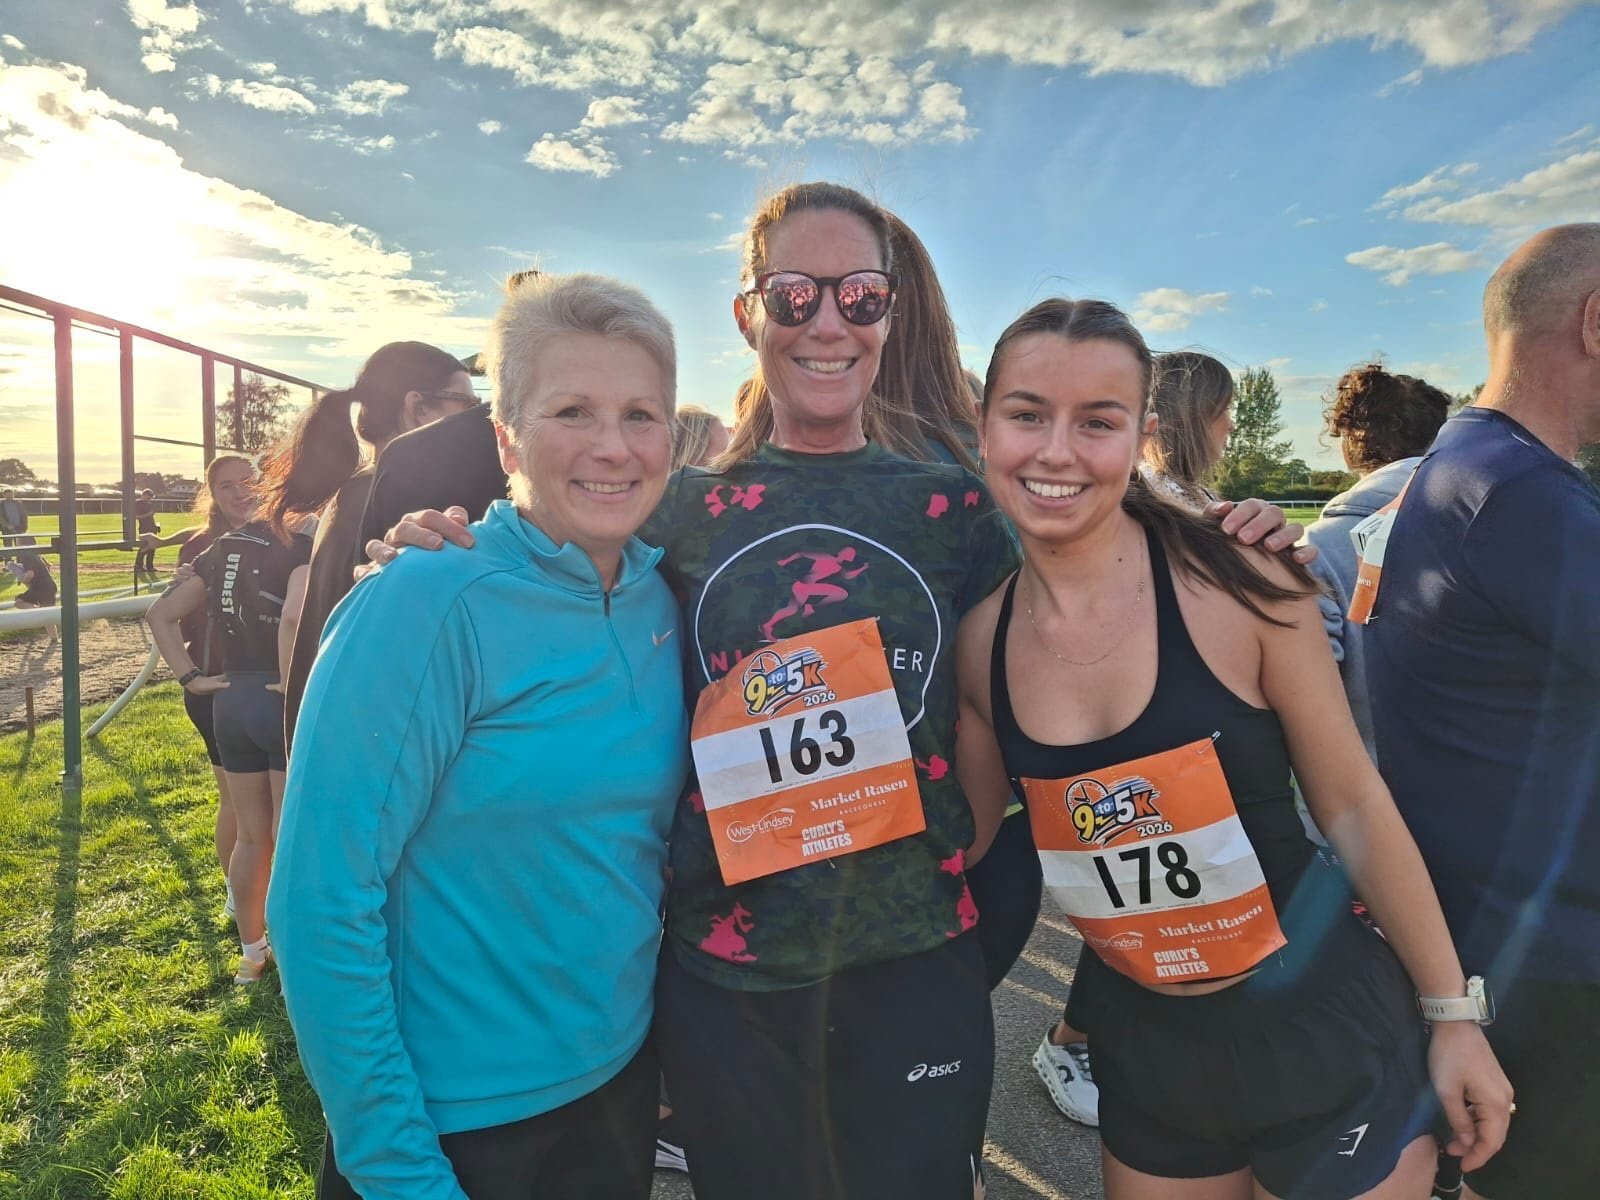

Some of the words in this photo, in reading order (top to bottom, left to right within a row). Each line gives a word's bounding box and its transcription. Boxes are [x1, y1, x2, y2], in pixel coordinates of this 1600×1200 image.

[221, 553, 241, 615] UTOBEST
[884, 648, 923, 673] ER
[803, 690, 836, 707] 2026
[759, 710, 856, 784] 163
[810, 789, 862, 812] Market
[865, 778, 908, 798] Rasen
[801, 819, 845, 841] CURLY'S
[1136, 821, 1173, 838] 2026
[801, 833, 853, 857] ATHLETES
[1093, 841, 1202, 909] 178
[1158, 920, 1215, 938] Market
[1217, 904, 1263, 930] Rasen
[1153, 947, 1200, 964] CURLY'S
[1155, 960, 1210, 978] ATHLETES
[927, 1059, 962, 1078] asics
